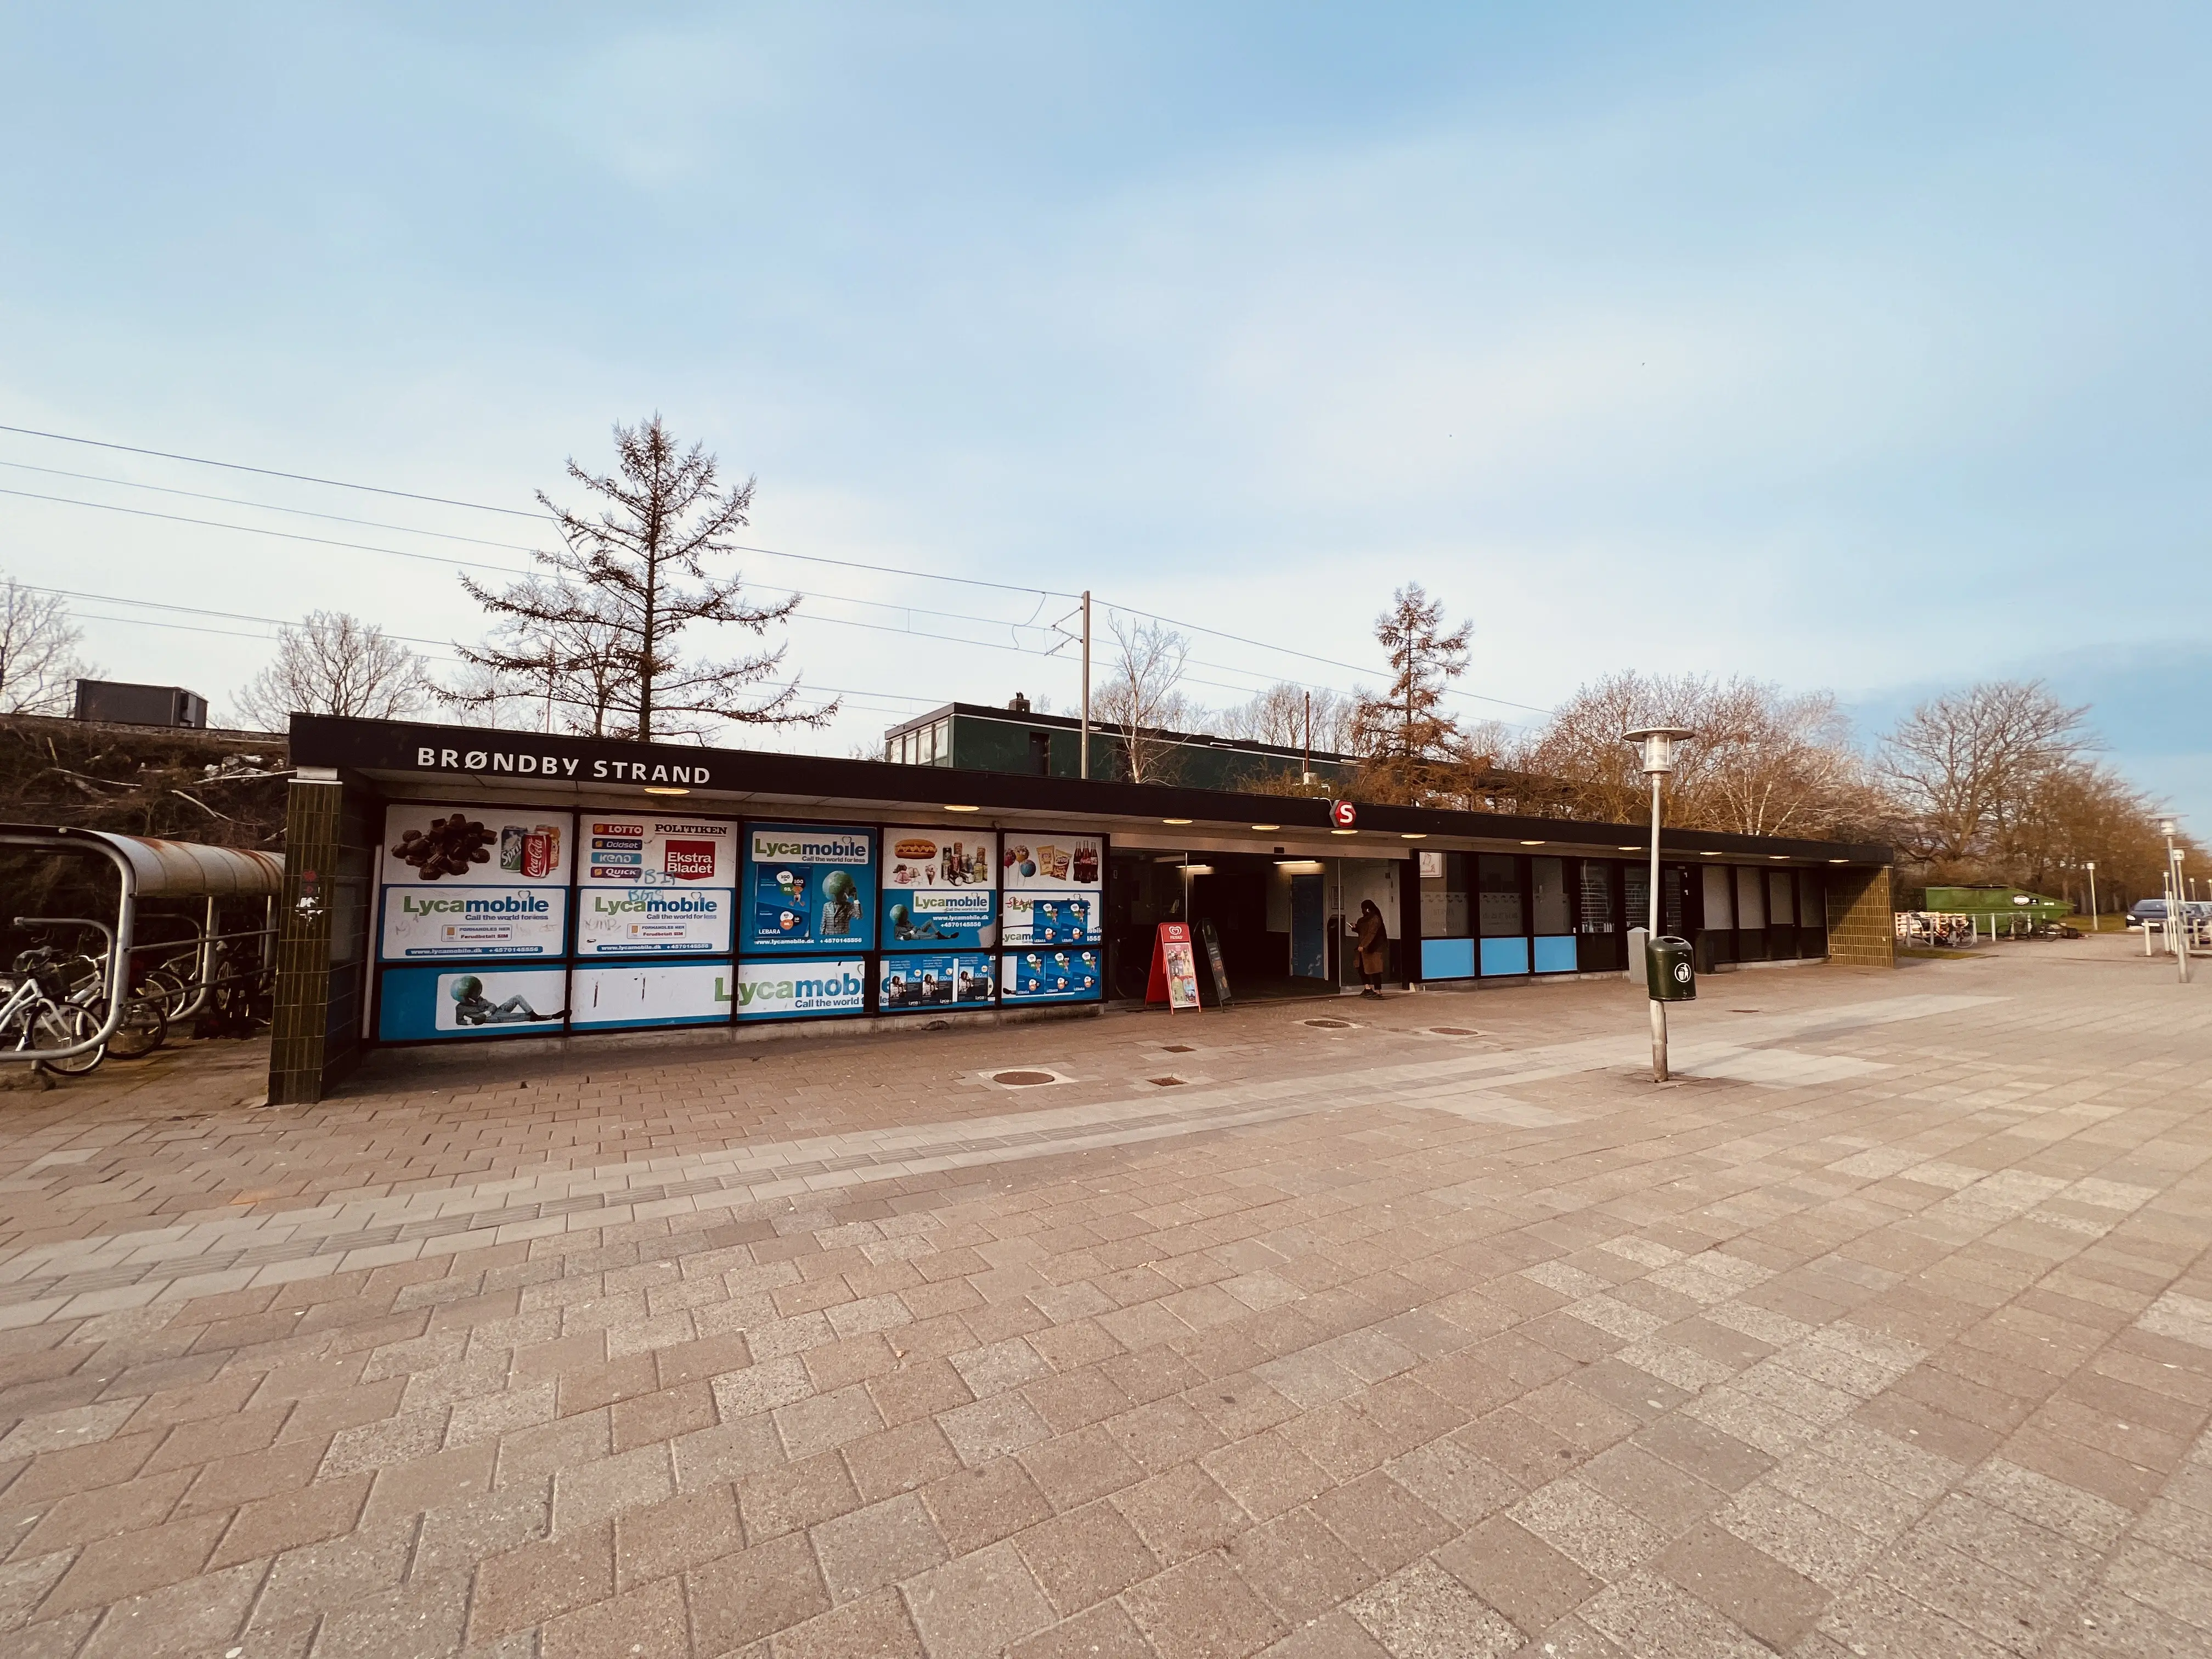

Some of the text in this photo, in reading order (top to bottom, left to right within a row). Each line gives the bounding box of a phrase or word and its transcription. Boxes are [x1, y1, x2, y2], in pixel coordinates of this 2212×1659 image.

[417, 747, 710, 784] BRØNDBY STRAND
[1340, 804, 1353, 823] S
[608, 825, 642, 834] LOTTO
[654, 823, 727, 834] POLITIKEN
[755, 838, 866, 857] Lycamobile
[668, 851, 713, 863] Ekstra
[667, 862, 713, 873] Bladet
[403, 895, 549, 917] Lycamobile
[595, 896, 718, 915] Lycamobile
[916, 896, 988, 909] Lycamobile
[714, 973, 865, 1006] Lycamob
[795, 999, 814, 1008] Call
[816, 998, 831, 1007] the
[833, 997, 859, 1006] world
